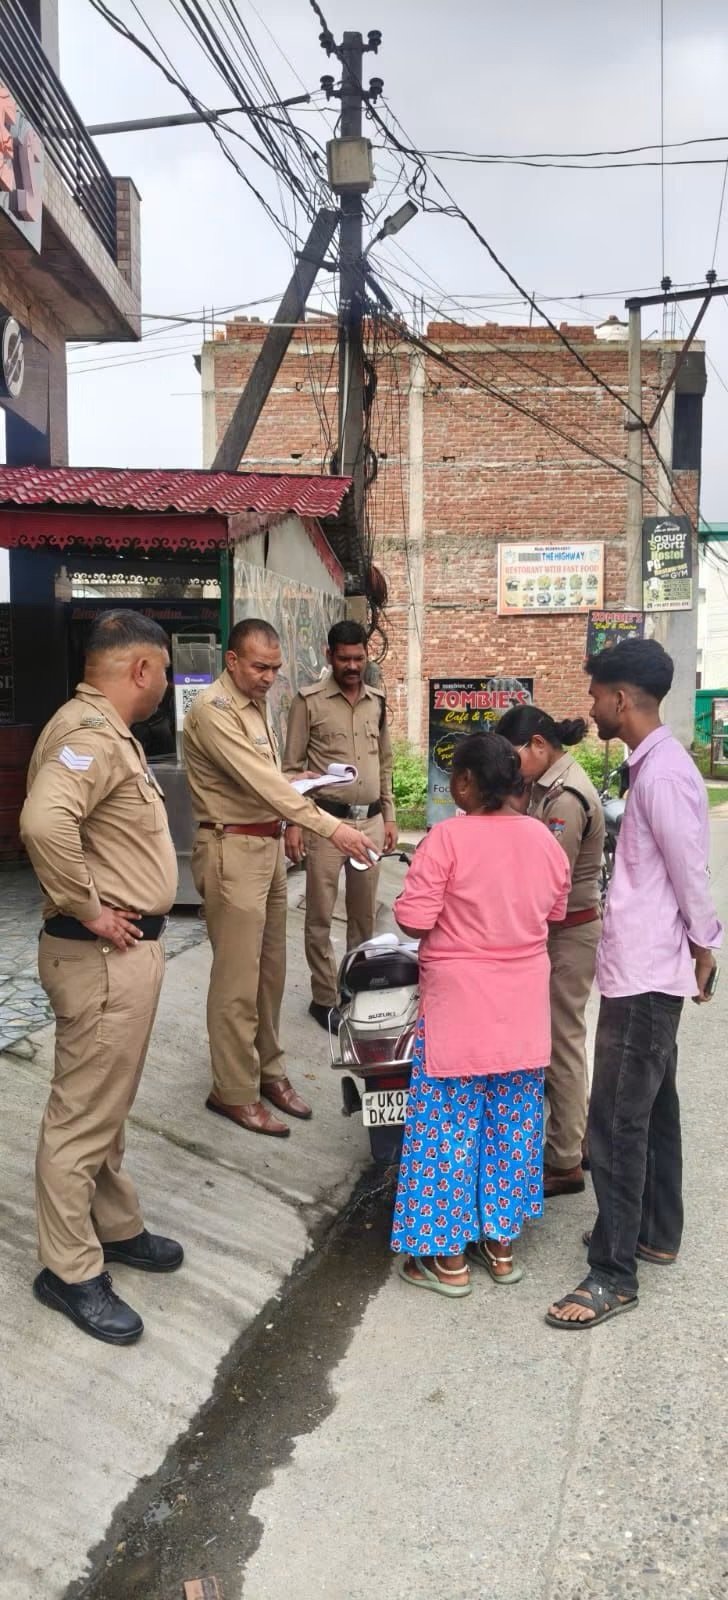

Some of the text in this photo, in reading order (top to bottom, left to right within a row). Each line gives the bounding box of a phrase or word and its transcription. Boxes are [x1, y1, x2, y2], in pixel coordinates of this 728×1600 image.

[648, 533, 687, 543] Jaguar
[650, 541, 685, 551] Sportz
[555, 551, 585, 560] HIGHWAY
[670, 569, 688, 578] GYM
[434, 690, 527, 710] ZOMBIE'S
[472, 711, 480, 720] &
[368, 1011, 396, 1019] SUZUKI
[369, 1108, 405, 1124] DK44
